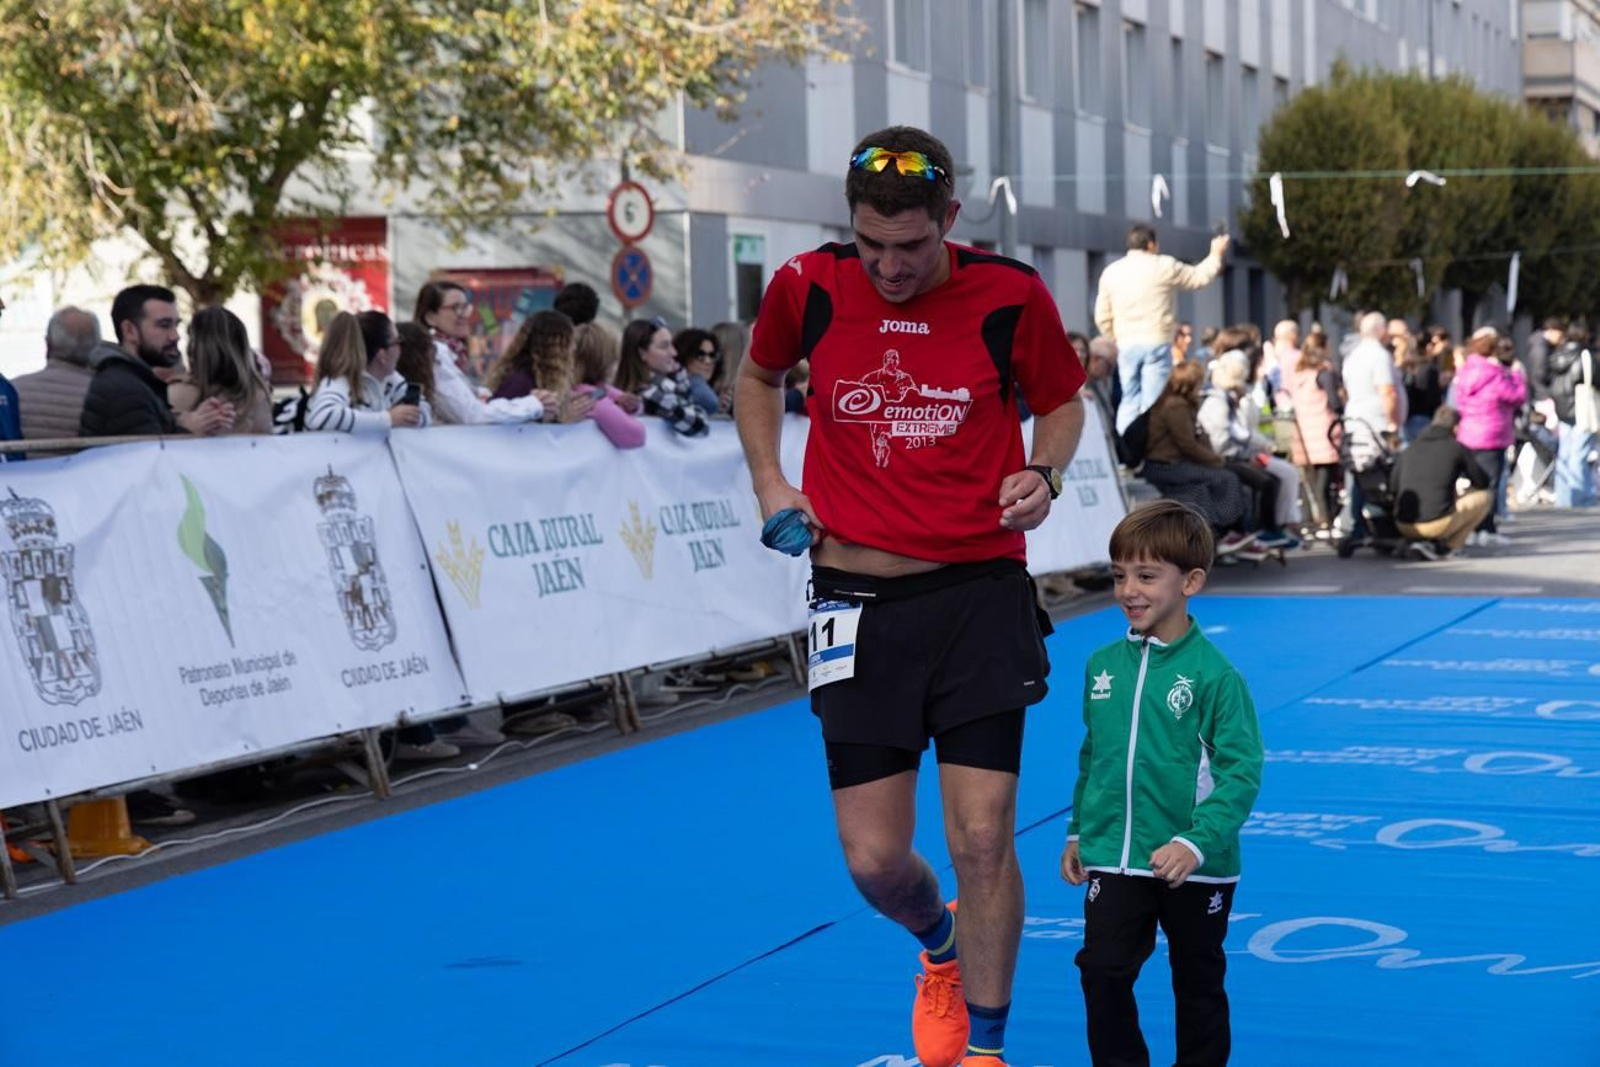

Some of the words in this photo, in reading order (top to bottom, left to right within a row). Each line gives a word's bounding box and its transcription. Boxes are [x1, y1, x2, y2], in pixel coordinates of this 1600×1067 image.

[884, 403, 967, 422] emotiON
[896, 421, 956, 435] EXTREME
[905, 435, 937, 450] 2013
[487, 521, 541, 558] CAJA
[539, 513, 604, 552] RURAL
[659, 503, 695, 536] CAJA
[691, 499, 741, 531] RURAL
[531, 553, 586, 598] JAÉN
[179, 663, 232, 685] Patronato
[231, 650, 282, 676] Municipal
[282, 650, 297, 667] de
[341, 664, 382, 689] CIUDAD
[381, 660, 399, 681] DE
[400, 651, 430, 678] JAÉN
[200, 684, 250, 709] Deportes
[250, 679, 266, 698] de
[266, 673, 293, 695] Jaén
[18, 721, 80, 753] CIUDAD
[79, 716, 105, 740] DE
[106, 705, 144, 736] JAÉN
